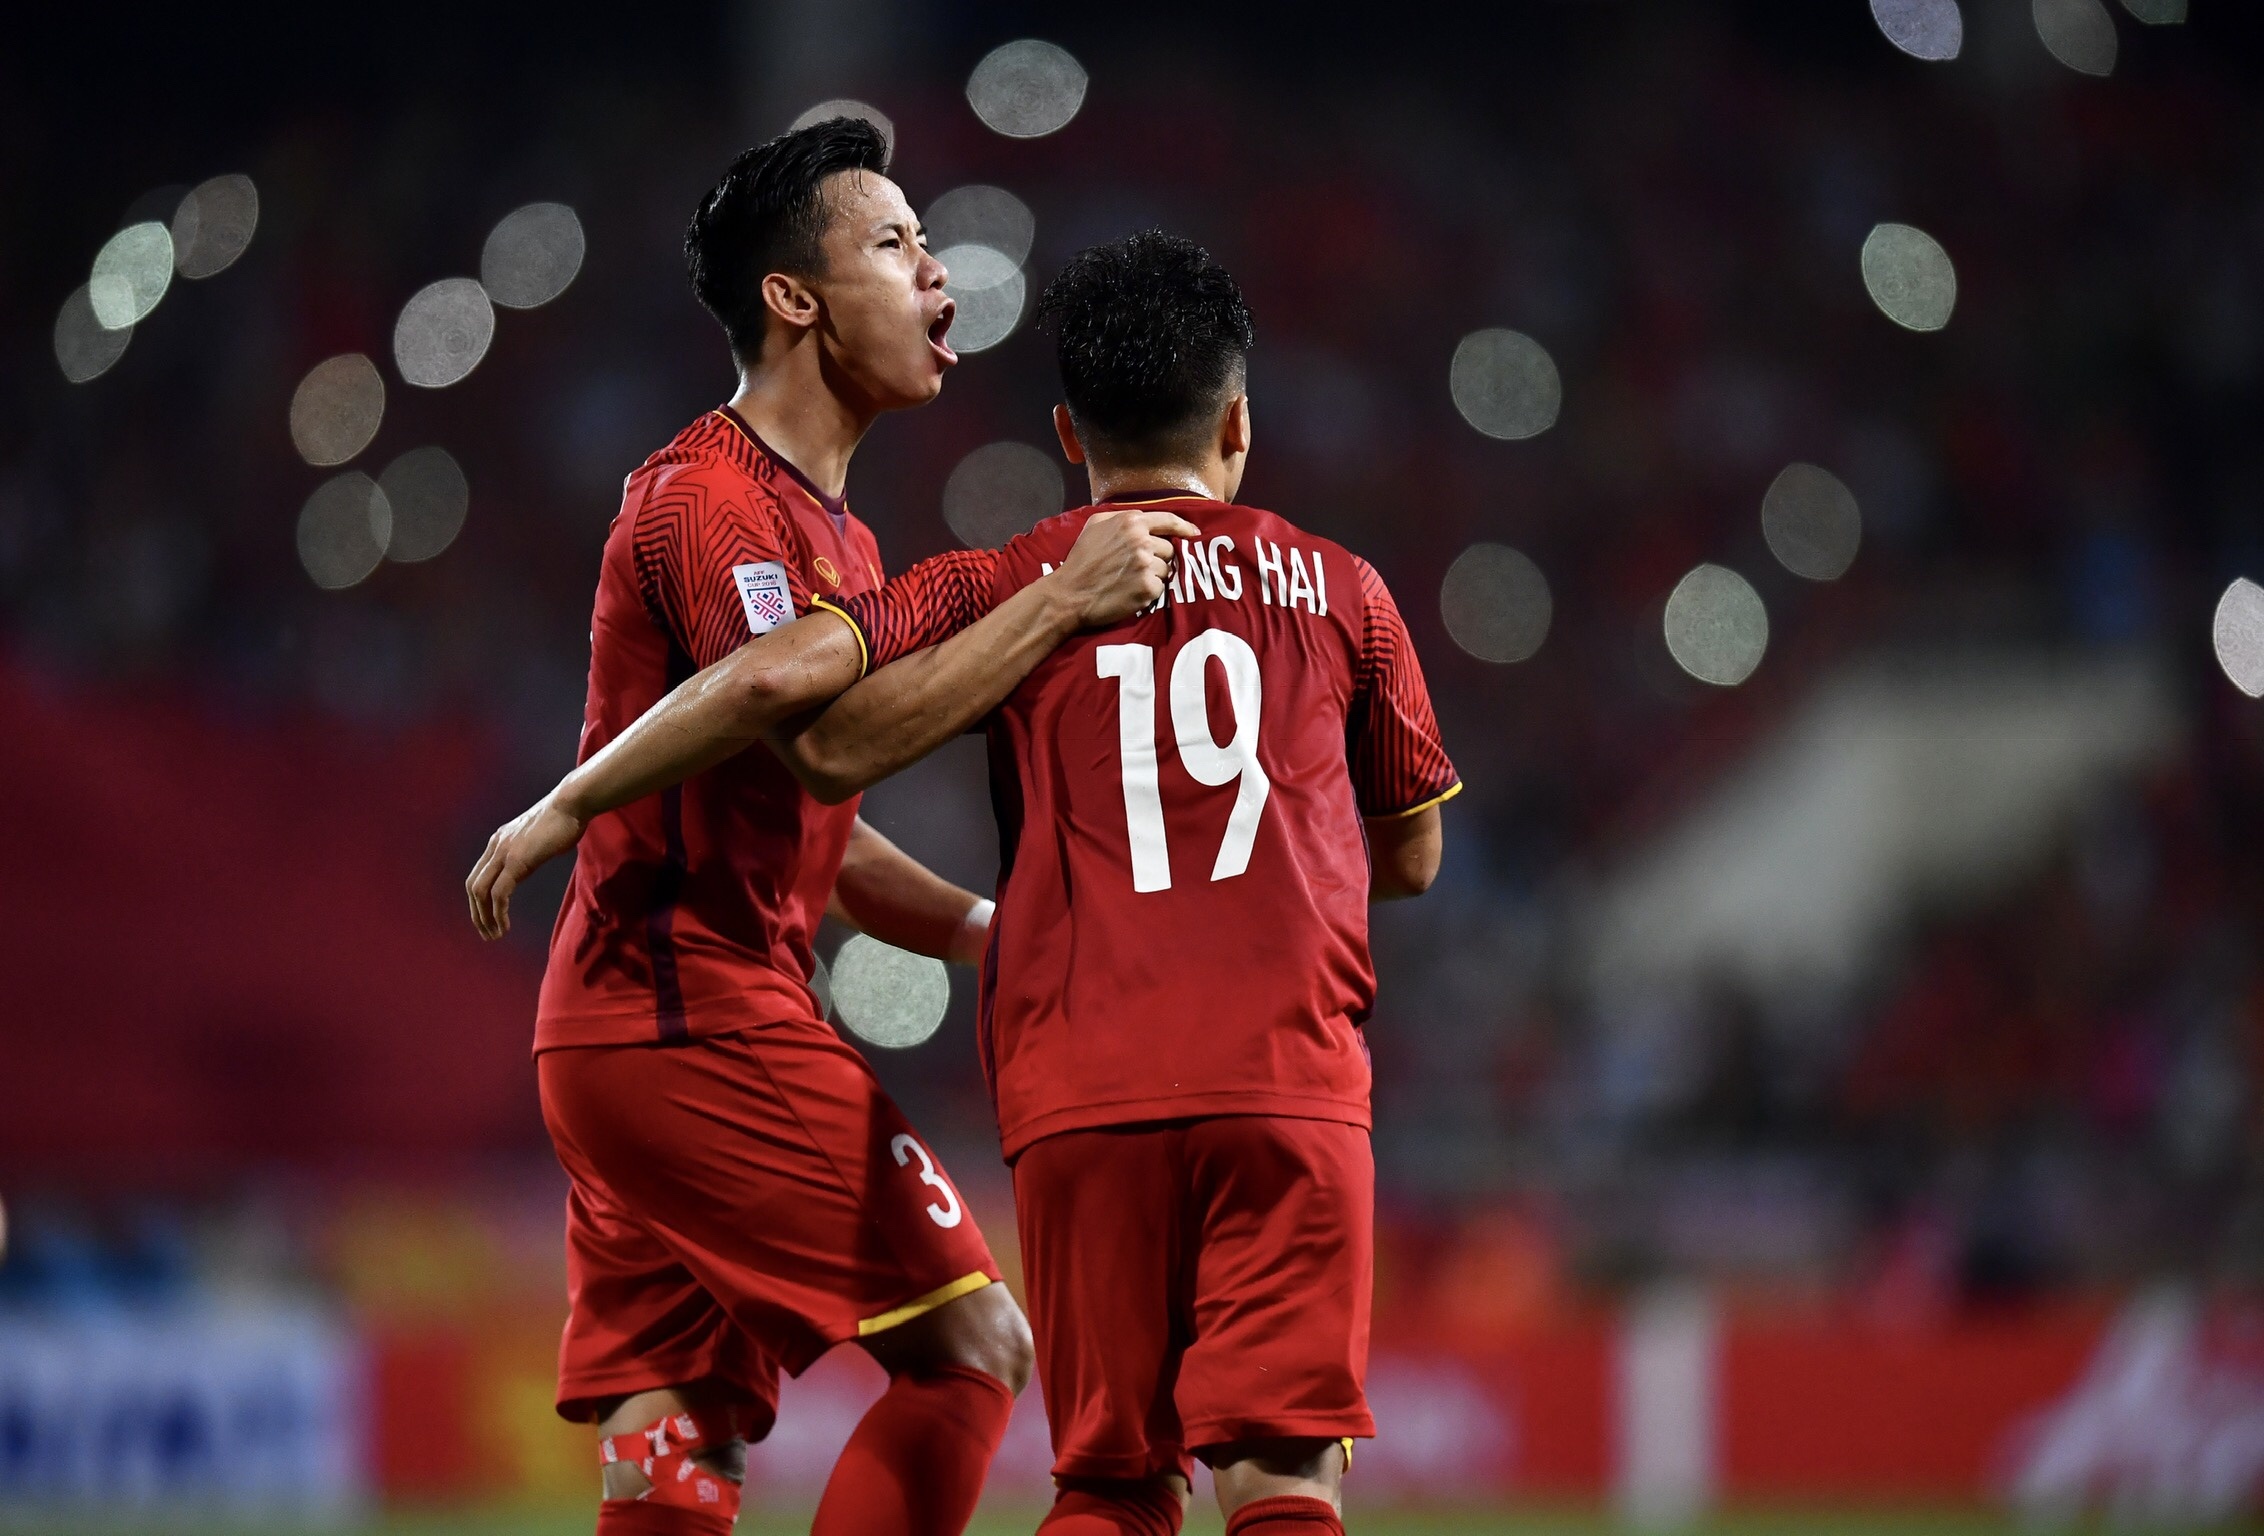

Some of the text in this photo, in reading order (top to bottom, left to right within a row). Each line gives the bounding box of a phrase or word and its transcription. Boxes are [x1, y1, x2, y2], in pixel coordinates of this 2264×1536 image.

[743, 574, 778, 583] SUZUKI
[1136, 535, 1328, 618] ANG HAI
[1096, 627, 1271, 893] 19
[890, 1133, 962, 1229] 3
